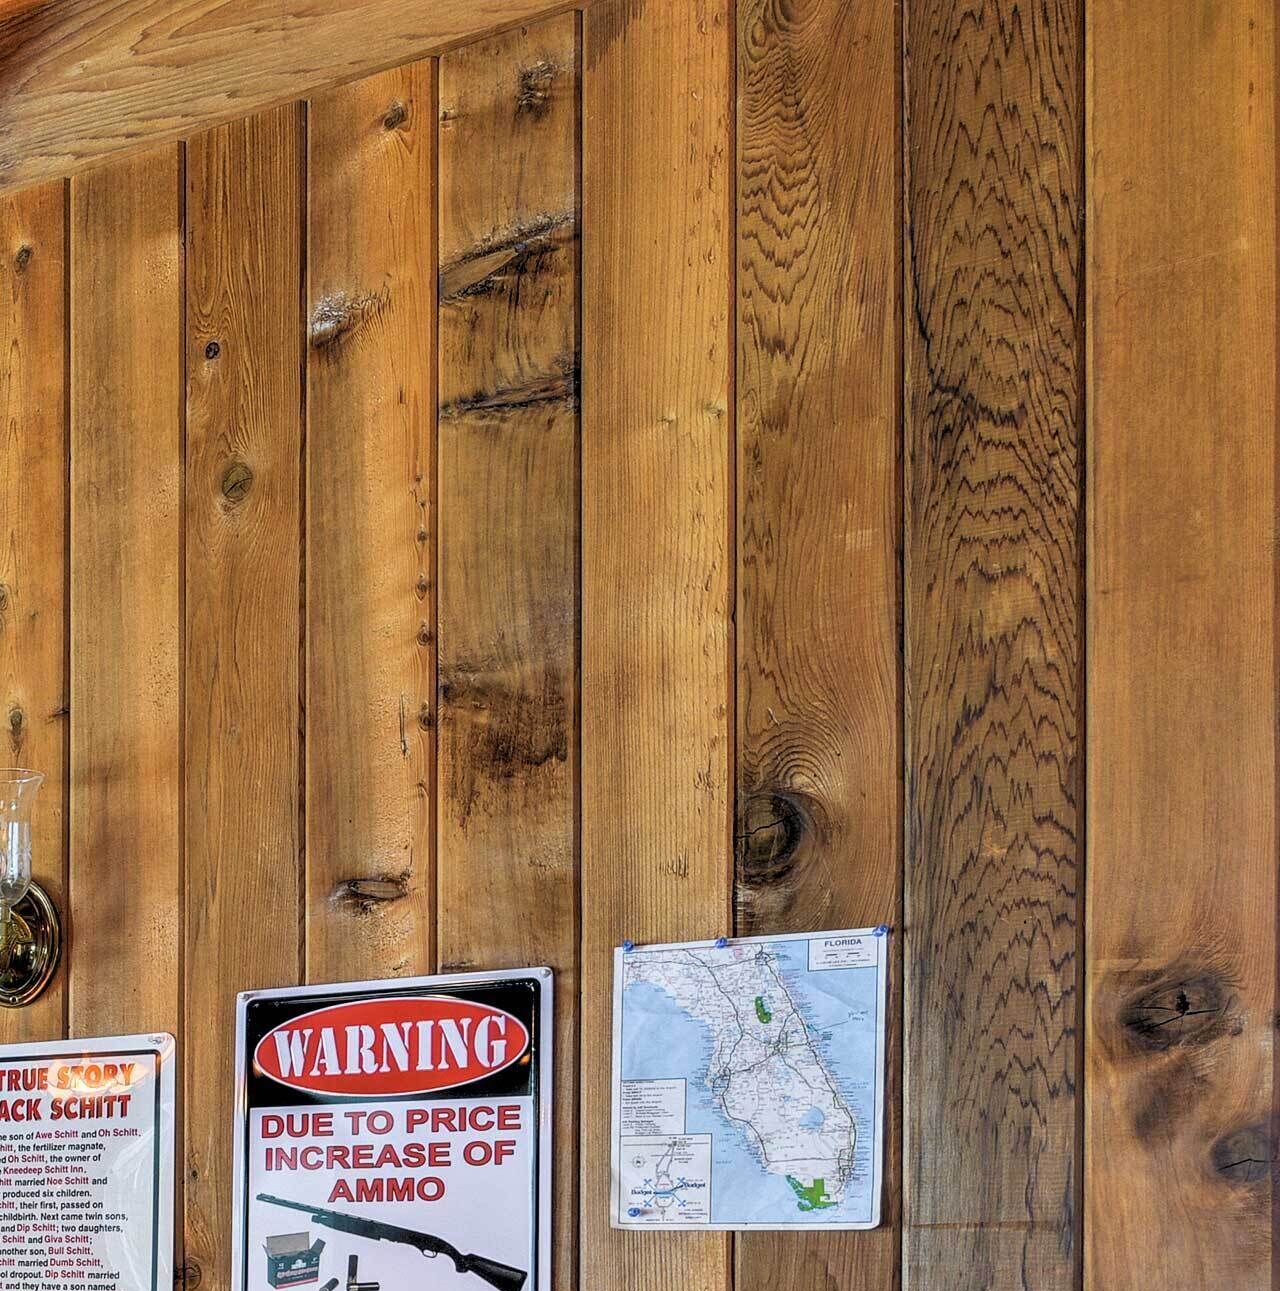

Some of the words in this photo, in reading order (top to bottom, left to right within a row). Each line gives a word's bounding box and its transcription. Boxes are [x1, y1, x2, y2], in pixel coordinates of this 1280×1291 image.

[824, 938, 862, 947] FLORIDA
[272, 1013, 509, 1078] WARNING
[56, 1064, 135, 1089] STORY
[50, 1094, 131, 1120] SCHITT
[261, 1112, 334, 1139] DUE
[344, 1110, 394, 1135] TO
[406, 1105, 522, 1134] PRICE
[24, 1131, 34, 1140] of
[54, 1130, 78, 1138] Schitt
[81, 1129, 97, 1138] and
[97, 1129, 110, 1137] Oh
[112, 1128, 141, 1136] Schitt.
[17, 1143, 30, 1151] the
[32, 1142, 66, 1151] fertilizer
[67, 1141, 106, 1152] magnate,
[7, 1155, 20, 1163] Oh
[20, 1154, 48, 1163] Schitt,
[49, 1153, 62, 1162] the
[91, 1152, 101, 1161] of
[264, 1142, 452, 1171] INCREASE
[463, 1140, 516, 1166] OF
[2, 1165, 42, 1176] Kneedeep
[44, 1165, 68, 1173] Schitt
[70, 1164, 87, 1173] Inn.
[14, 1177, 45, 1186] married
[46, 1177, 63, 1185] Noe
[64, 1176, 90, 1184] Schitt
[91, 1176, 107, 1184] and
[1, 1190, 40, 1199] produced
[55, 1189, 92, 1197] children.
[328, 1176, 446, 1203] AMMO
[19, 1201, 37, 1209] their
[40, 1200, 59, 1209] first,
[59, 1200, 91, 1210] passed
[40, 1212, 59, 1220] Next
[85, 1212, 103, 1220] twin
[0, 1224, 15, 1232] and
[16, 1224, 30, 1233] Dip
[31, 1223, 59, 1232] Schitt;
[60, 1224, 77, 1232] two
[76, 1223, 123, 1233] daughters,
[1, 1235, 25, 1243] Schitt
[27, 1235, 43, 1243] and
[44, 1234, 63, 1243] Giva
[64, 1234, 92, 1243] Schitt;
[16, 1258, 48, 1266] married
[49, 1258, 75, 1266] Dumb
[75, 1258, 103, 1267] Schitt,
[9, 1270, 43, 1280] dropout.
[44, 1270, 59, 1280] Dip
[59, 1270, 84, 1278] Schitt
[86, 1270, 119, 1279] married
